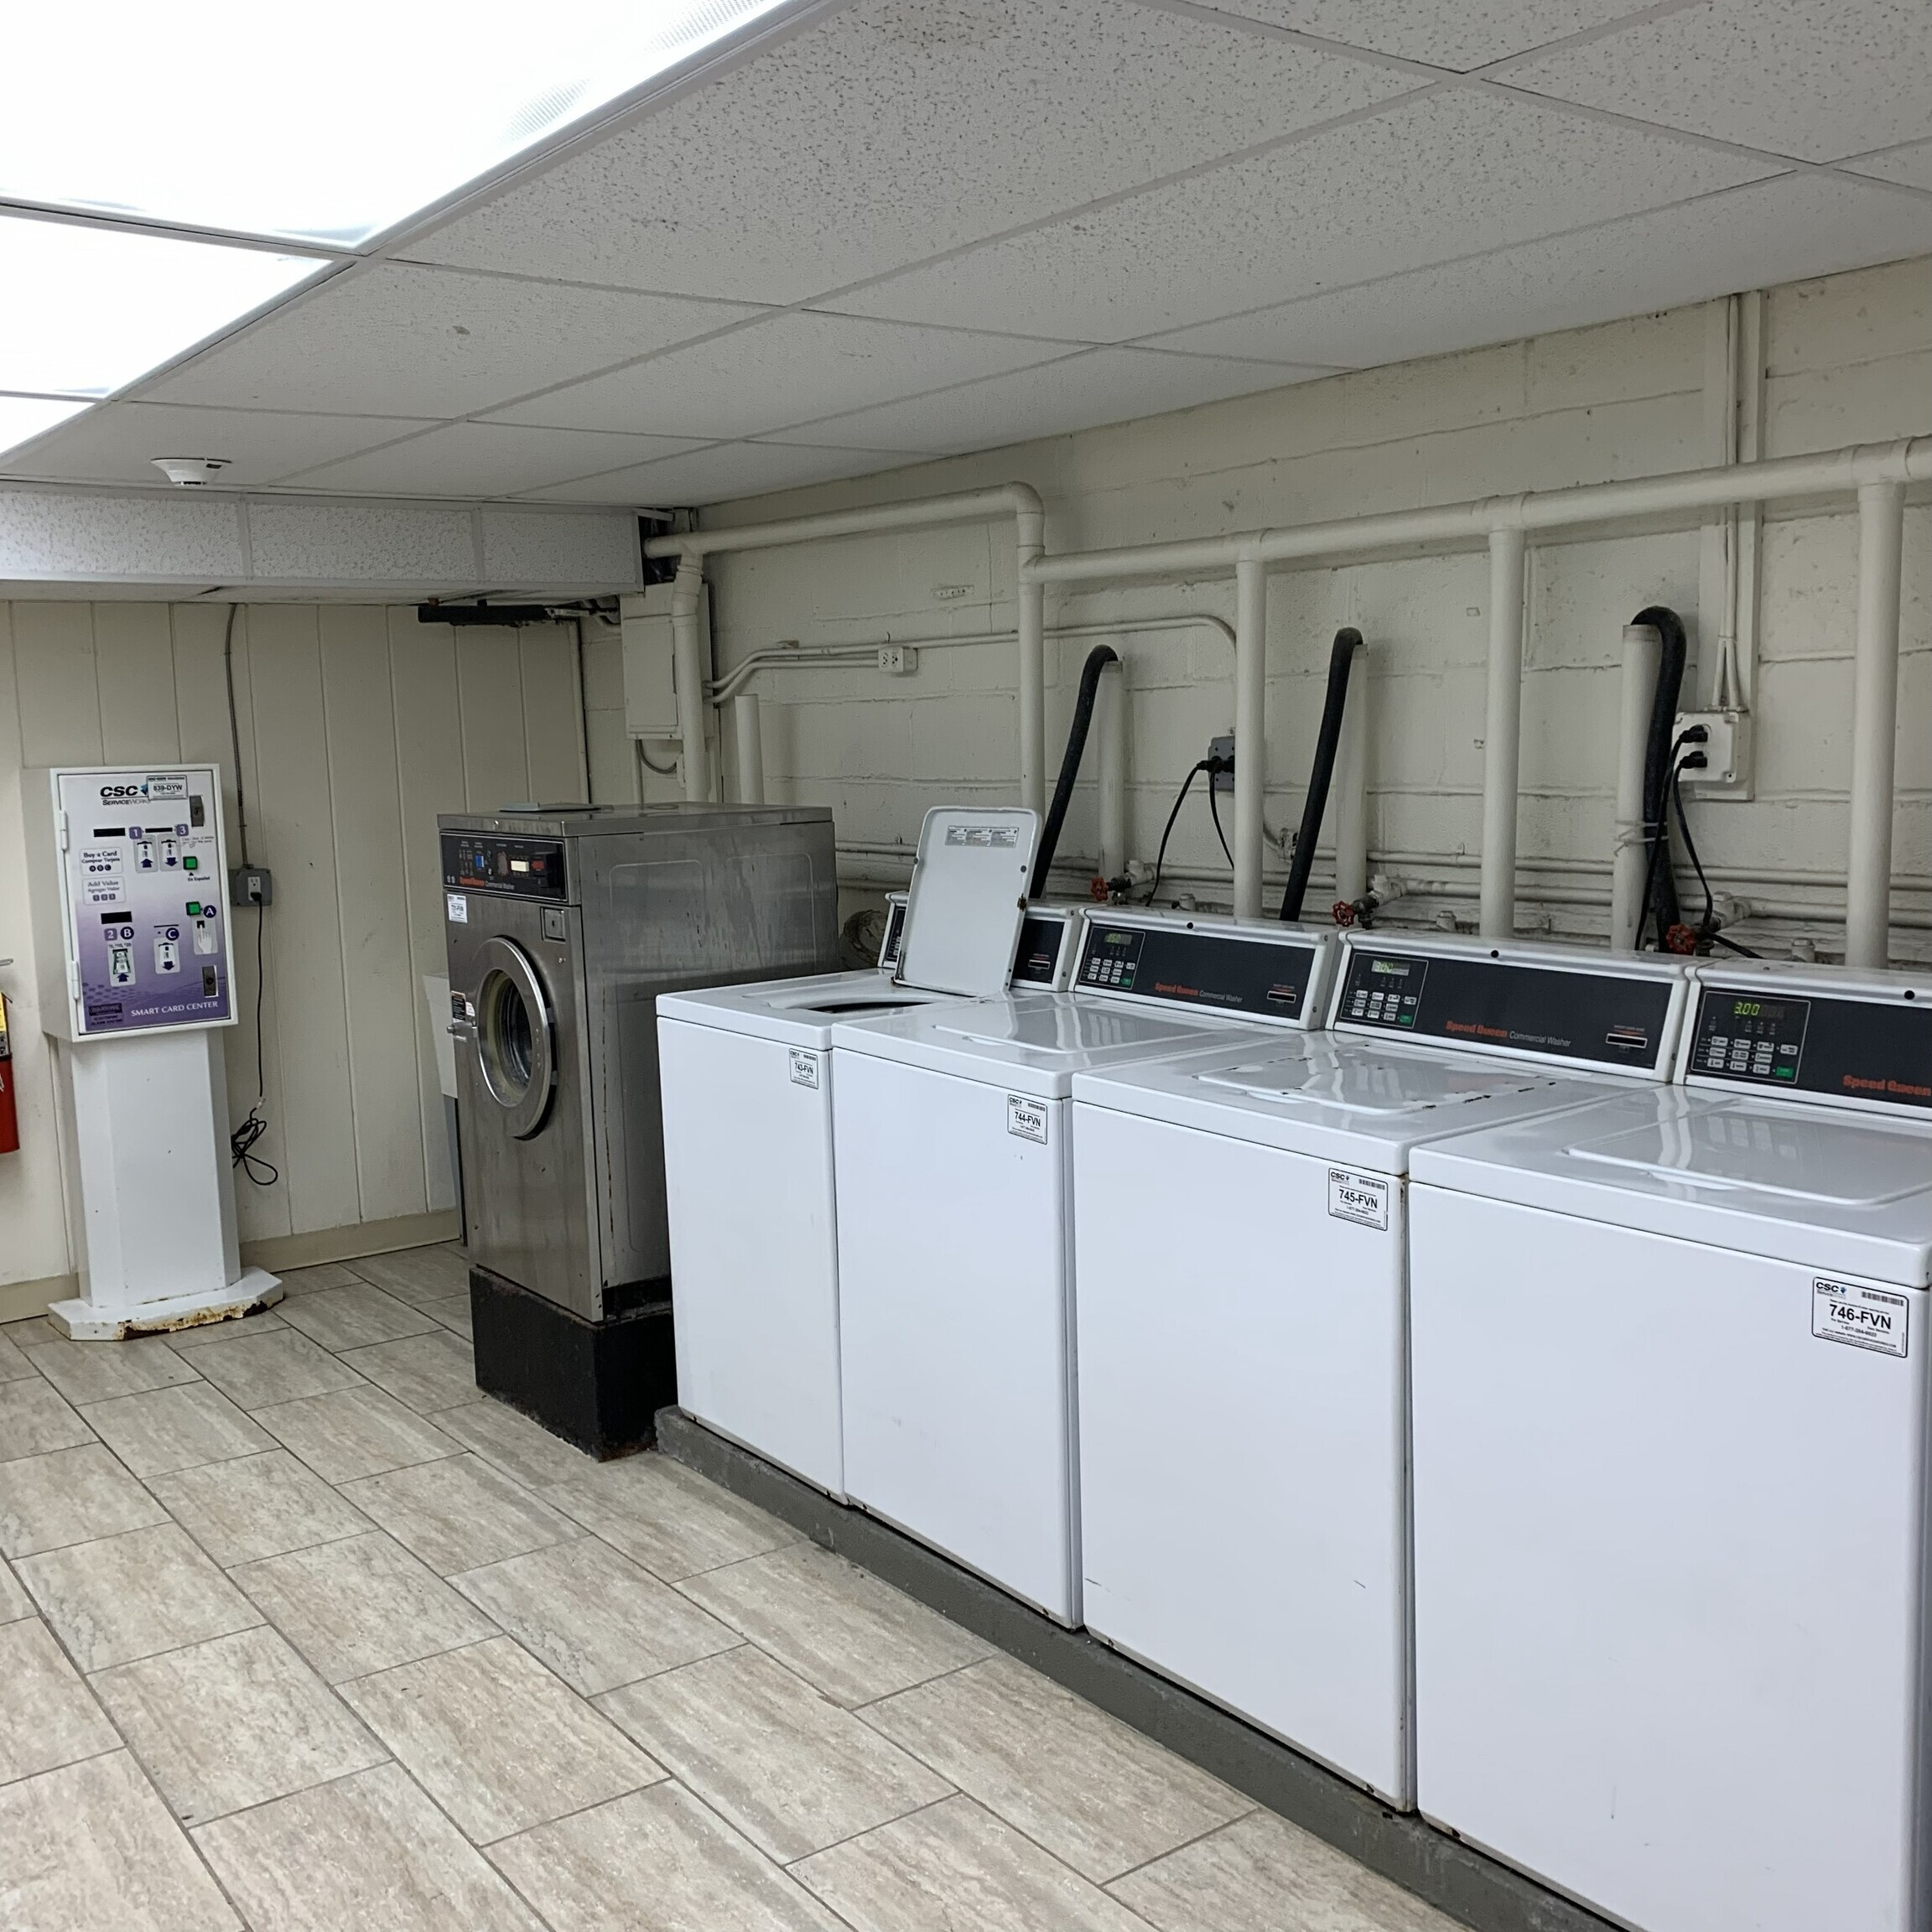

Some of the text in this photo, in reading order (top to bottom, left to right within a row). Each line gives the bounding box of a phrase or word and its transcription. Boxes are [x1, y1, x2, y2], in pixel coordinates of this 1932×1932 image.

[100, 785, 138, 797] CSC
[131, 1000, 218, 1017] SMART CARD CENTER
[1446, 1020, 1571, 1047] Speed Queen Commercial Washer
[1843, 1074, 1932, 1097] Speed Queen
[1015, 1111, 1041, 1127] 744-FVN
[1331, 1171, 1345, 1180] CSC
[1339, 1189, 1378, 1208] 745-FVN
[1816, 1282, 1839, 1292] CSC
[1830, 1304, 1891, 1330] 746-FVN
